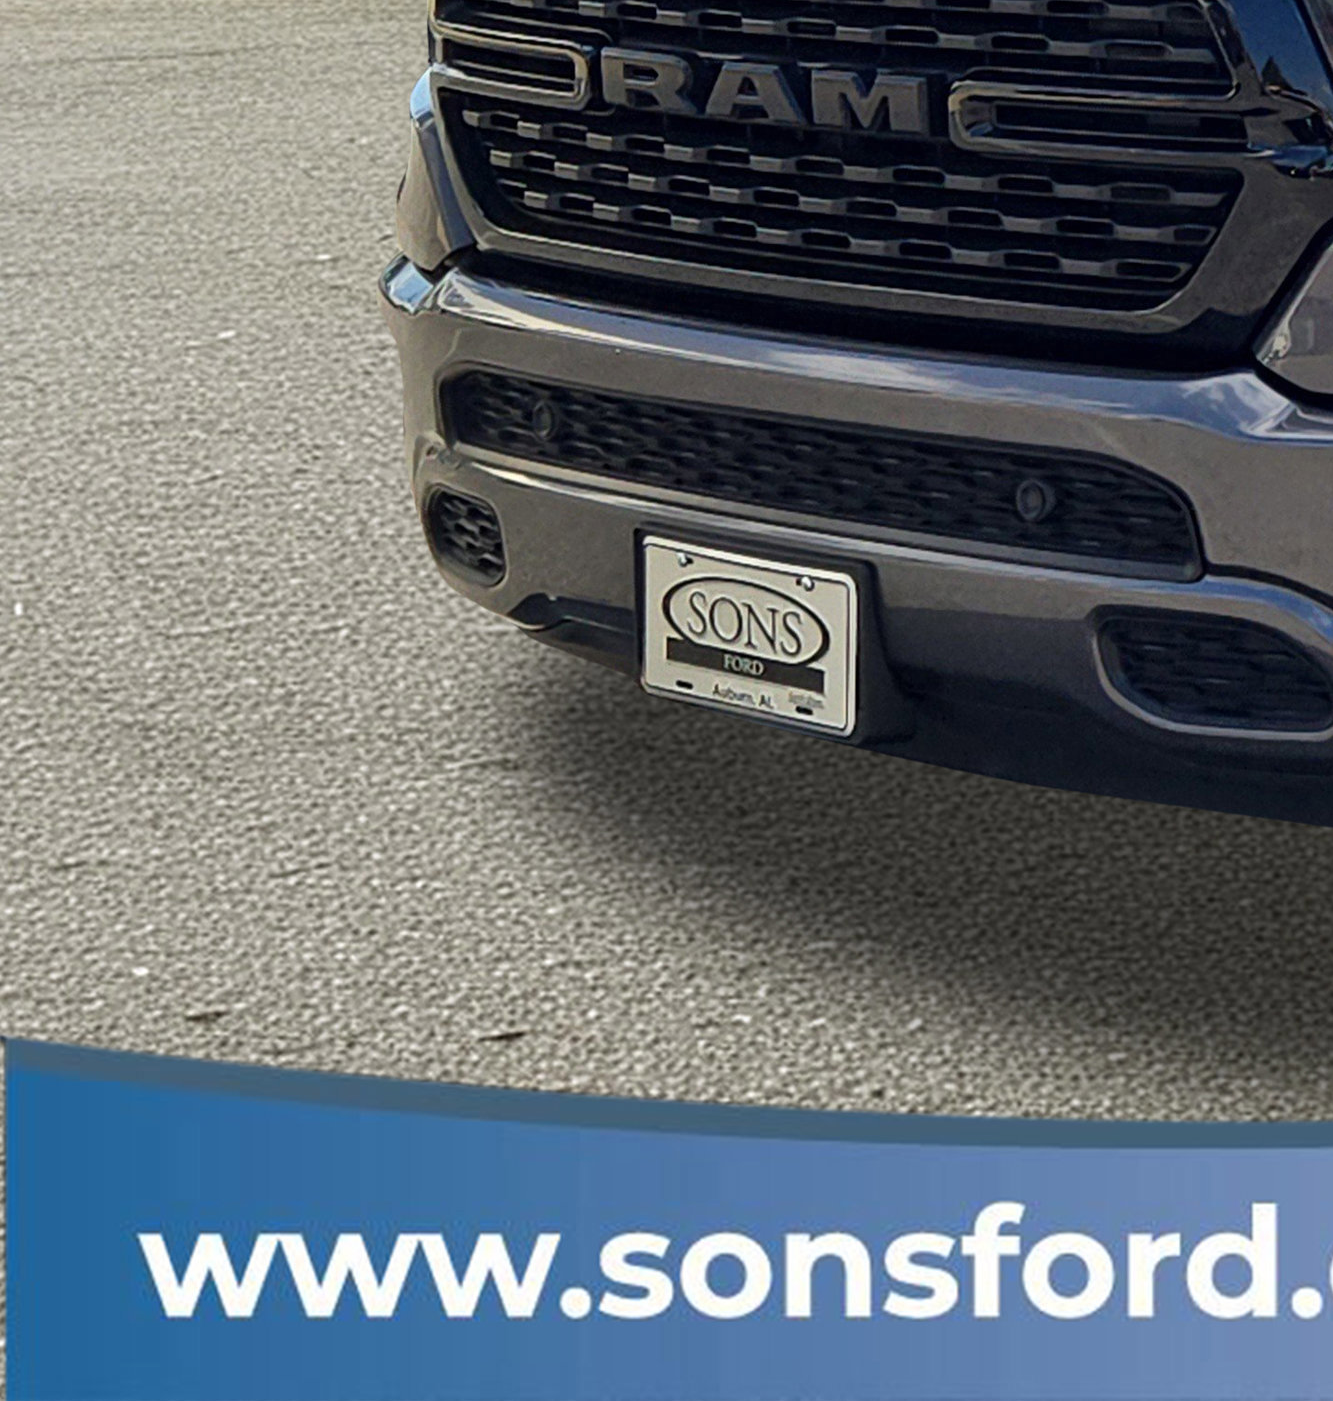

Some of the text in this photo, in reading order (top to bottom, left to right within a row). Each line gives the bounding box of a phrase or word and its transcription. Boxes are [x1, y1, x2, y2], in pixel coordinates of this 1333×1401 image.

[600, 46, 933, 136] RAM
[686, 590, 803, 657] SONS
[723, 653, 765, 677] FORD
